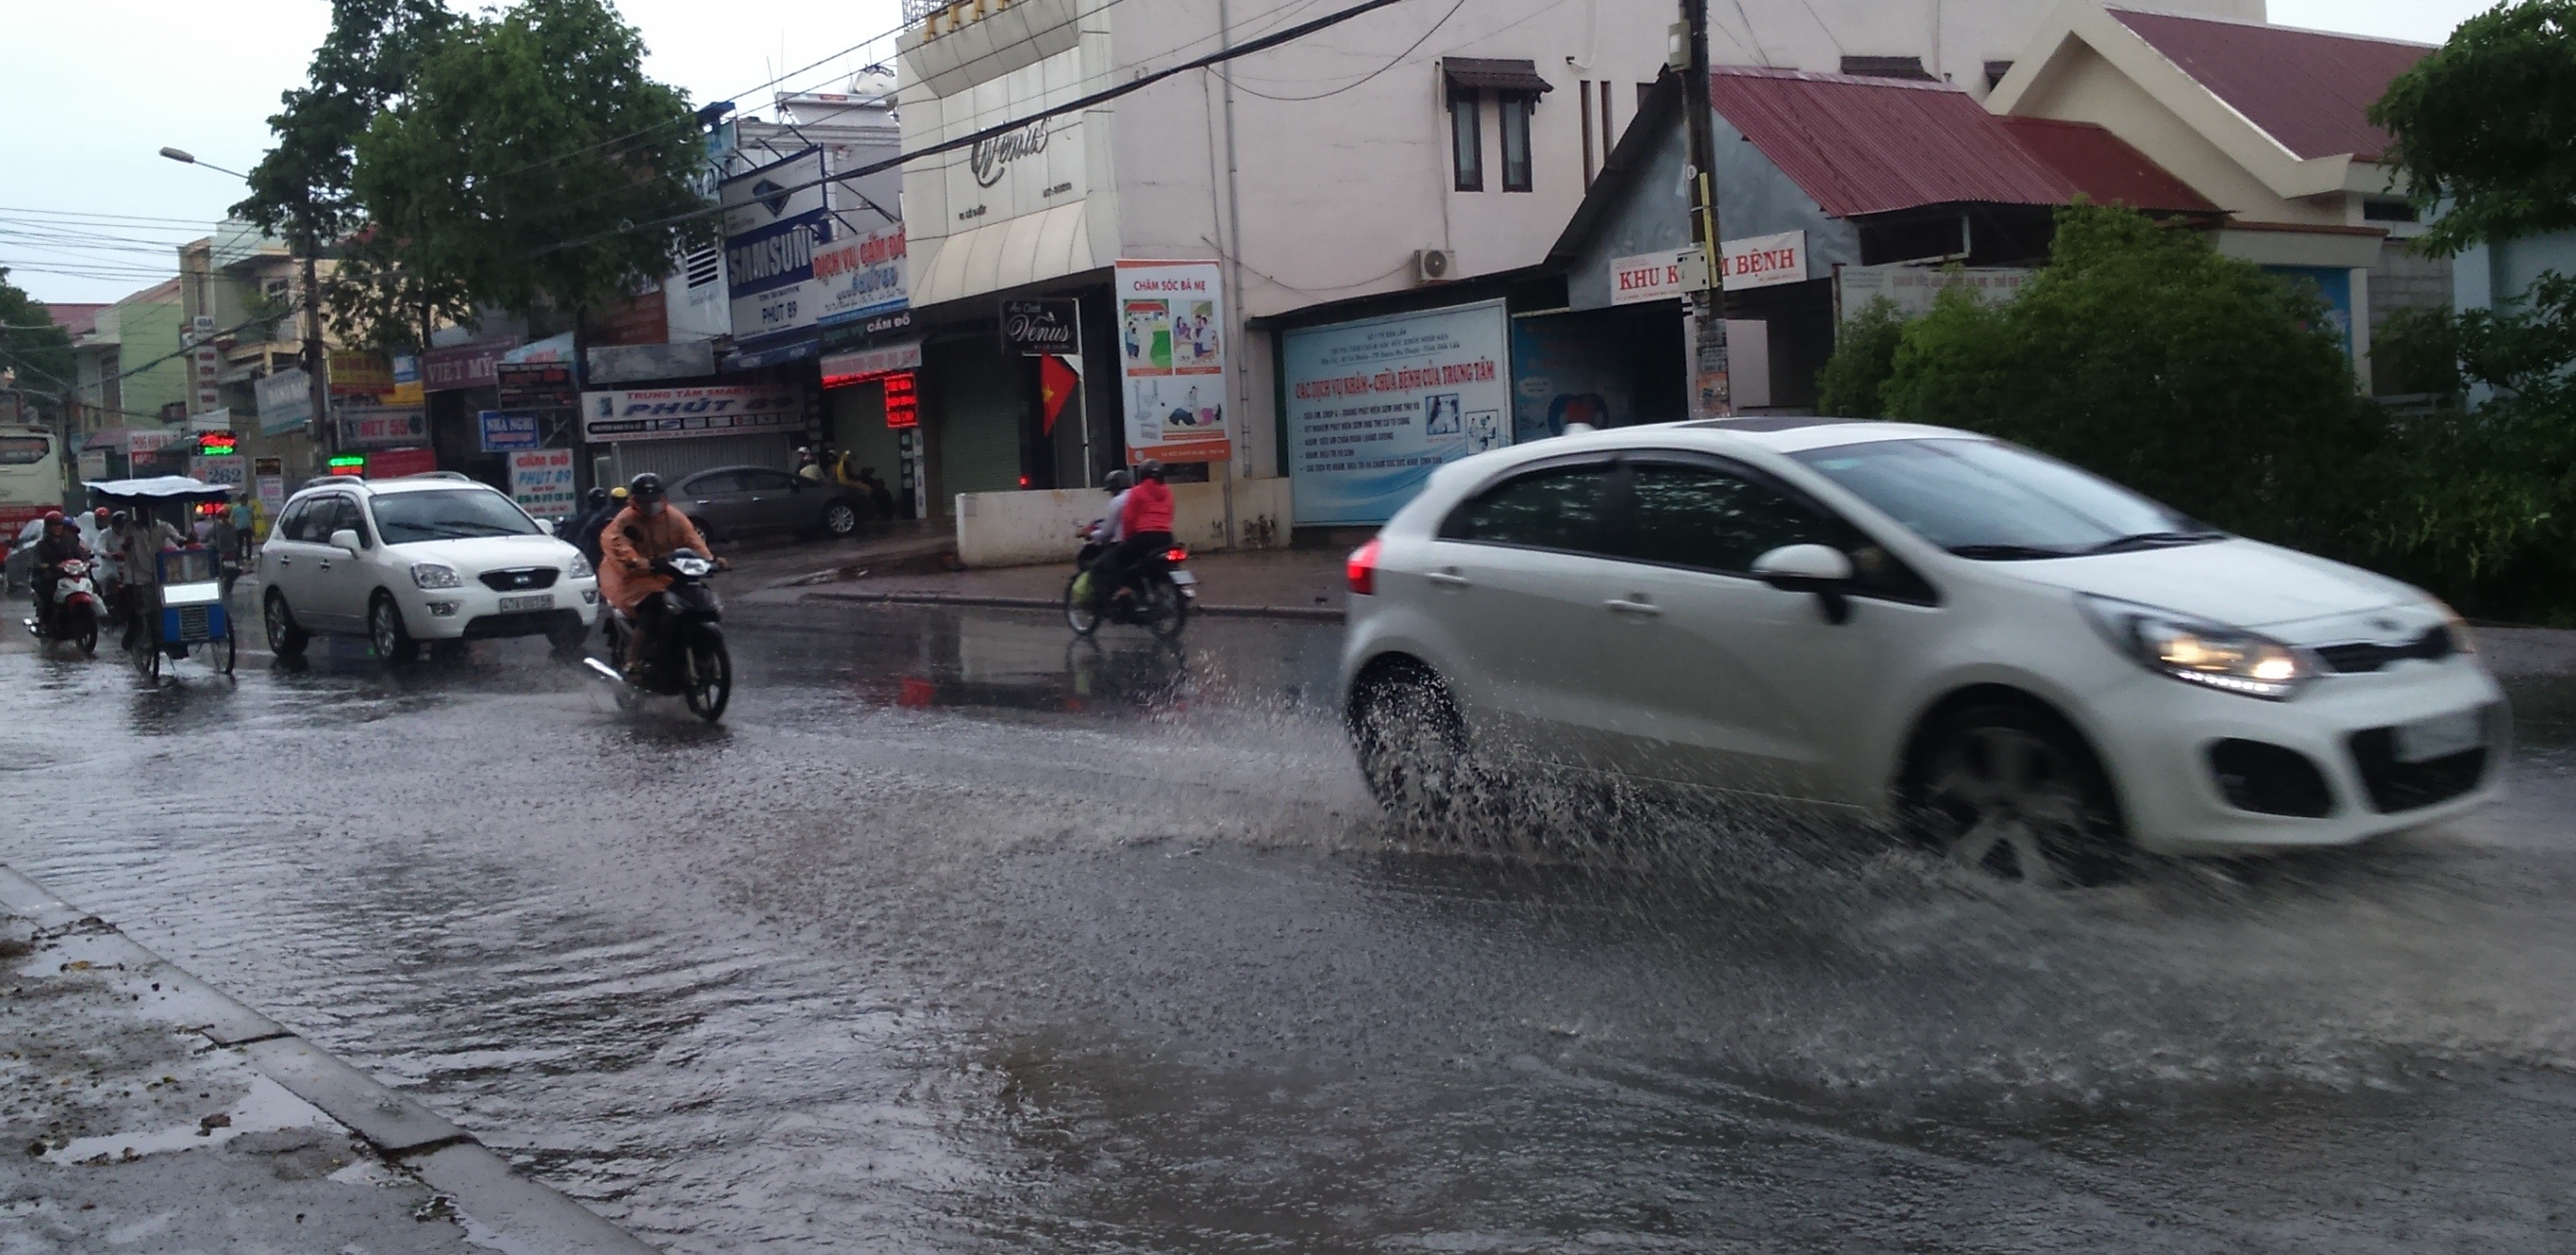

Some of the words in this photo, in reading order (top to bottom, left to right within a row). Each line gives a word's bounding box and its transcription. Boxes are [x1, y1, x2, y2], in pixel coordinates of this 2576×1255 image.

[1619, 267, 1660, 291] KHU
[1735, 248, 1795, 277] BỆNH
[1133, 278, 1159, 292] CHĂM
[1162, 278, 1179, 292] SÓC
[762, 300, 784, 324] PHÚT
[1008, 314, 1070, 342] Venus
[428, 355, 464, 385] VIỆT
[1312, 380, 1331, 402] DỊCH
[1344, 371, 1369, 395] KHÁM
[1374, 368, 1396, 391] CHỮA
[1398, 366, 1421, 395] BỆNH
[1442, 363, 1473, 385] TRUNG
[1473, 355, 1496, 381] TÂM
[626, 390, 671, 400] TRUNG
[676, 388, 703, 399] TÂM
[622, 397, 734, 417] PHÚT
[361, 420, 385, 436] NET
[389, 419, 409, 436] 55
[207, 466, 242, 484] 262
